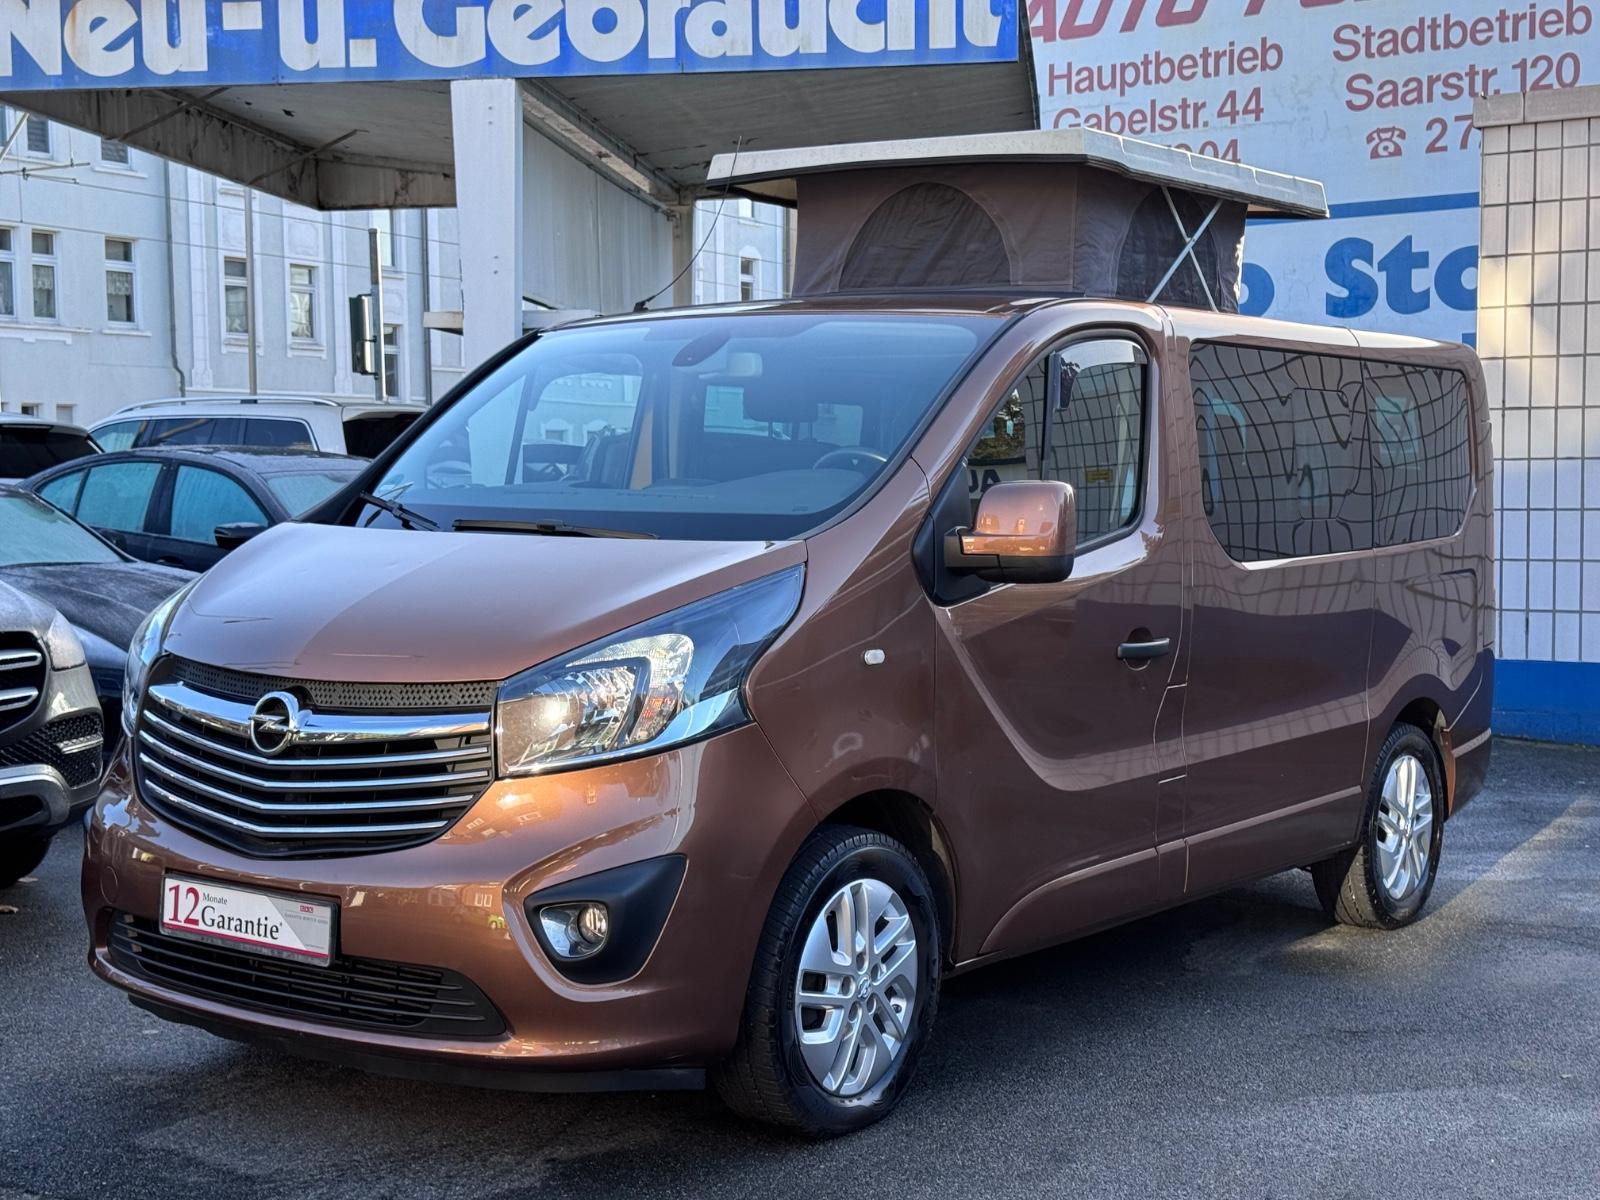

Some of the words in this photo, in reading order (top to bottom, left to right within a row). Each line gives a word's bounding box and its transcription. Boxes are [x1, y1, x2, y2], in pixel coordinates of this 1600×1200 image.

[1333, 0, 1592, 61] Stadtbetrieb
[1048, 36, 1284, 97] Hauptbetrieb
[1345, 64, 1500, 112] Saarstr.
[1512, 52, 1581, 93] 120
[1216, 87, 1264, 125] 44
[168, 884, 200, 926] 12
[202, 892, 228, 905] Monate
